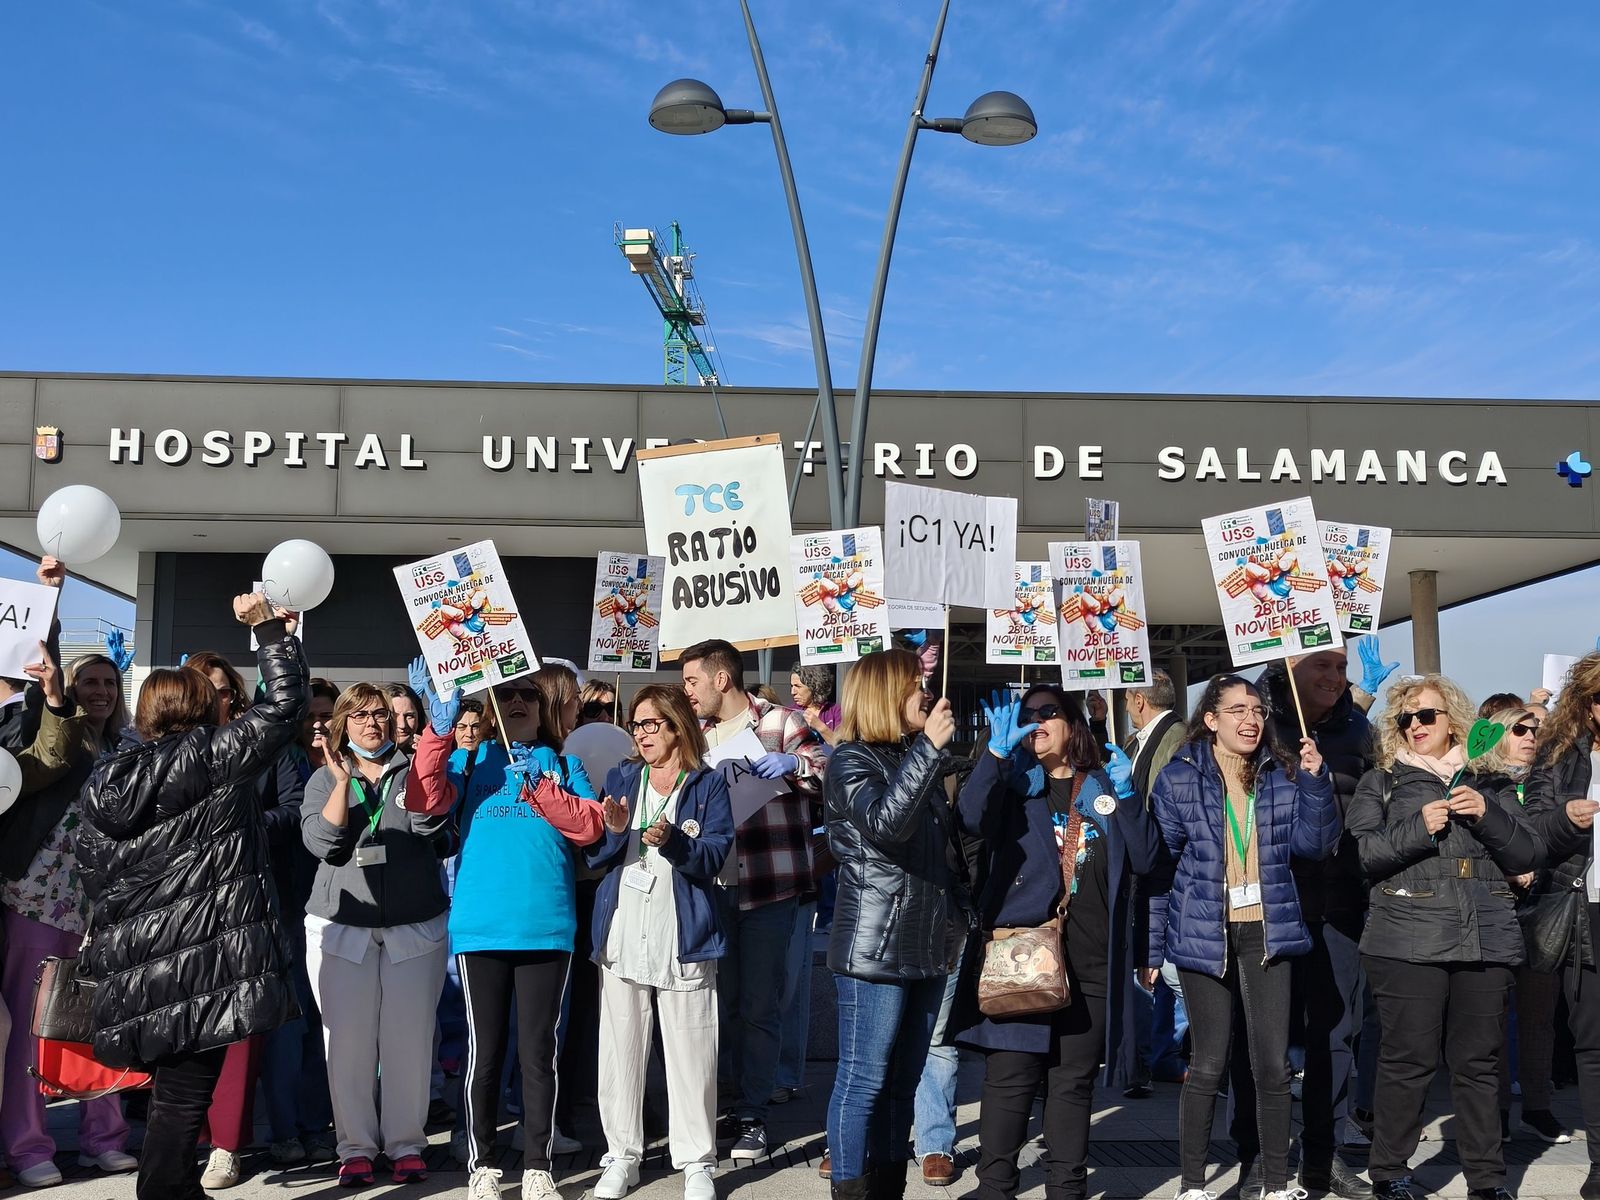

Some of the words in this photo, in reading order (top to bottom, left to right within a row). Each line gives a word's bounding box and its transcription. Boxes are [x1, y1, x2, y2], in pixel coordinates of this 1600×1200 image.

[109, 427, 425, 470] HOSPITAL
[482, 435, 979, 477] UNIVTRIO
[1034, 445, 1105, 480] DE
[1157, 446, 1509, 485] SALAMANCA
[674, 481, 744, 517] TCE
[900, 515, 940, 547] ¡C1
[953, 520, 994, 552] YA!
[1222, 526, 1255, 543] USO
[1325, 532, 1348, 544] USO
[804, 546, 832, 559] USO
[1218, 547, 1262, 561] CONVOCAN
[1264, 540, 1295, 553] HUELGA
[1297, 535, 1307, 545] DE
[608, 564, 629, 576] USO
[799, 563, 836, 574] CONVOCAN
[838, 560, 863, 570] HUELGA
[864, 559, 873, 567] DE
[1064, 557, 1092, 569] USO
[415, 571, 445, 589] USO
[601, 580, 630, 589] CONVOCAN
[1059, 577, 1097, 586] CONVOCAN
[1098, 576, 1124, 585] HUELGA
[1125, 575, 1133, 584] DE
[414, 588, 455, 607] CONVOCAN
[456, 579, 484, 594] HUELGA
[484, 574, 495, 584] DE
[1333, 589, 1339, 598] 8
[1342, 591, 1357, 601] DE
[1253, 603, 1271, 619] 28
[1276, 598, 1297, 613] DE
[0, 602, 31, 630] A!
[823, 613, 838, 626] 28
[840, 611, 858, 623] DE
[1234, 608, 1322, 636] NOVIEMBRE
[611, 627, 623, 638] 28
[625, 627, 638, 638] DE
[805, 622, 878, 640] NOVIEMBRE
[1008, 625, 1021, 635] 28
[1023, 625, 1037, 635] DE
[452, 639, 470, 656] 28
[473, 631, 493, 648] DE
[596, 637, 650, 651] NOVIEMBRE
[992, 635, 1052, 646] NOVIEMBRE
[1084, 634, 1099, 647] 28
[1103, 633, 1120, 645] DE
[437, 638, 518, 675] NOVIEMBRE
[1067, 646, 1140, 662] NOVIEMBRE
[1479, 725, 1497, 739] C1
[1472, 739, 1486, 751] YA
[503, 784, 512, 796] EL
[486, 805, 528, 818] HOSPITAL
